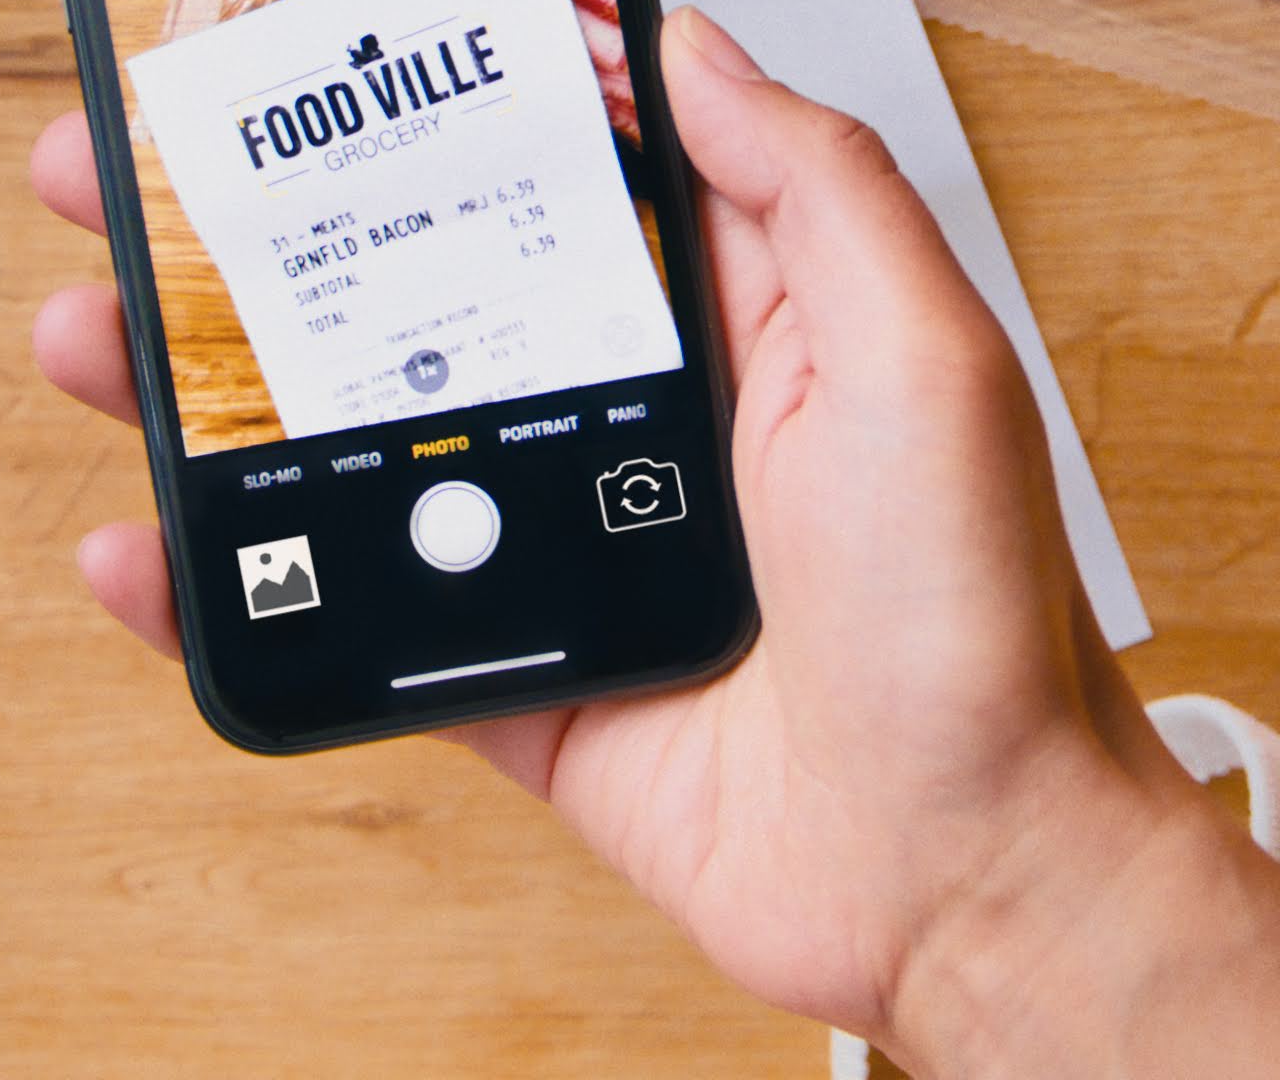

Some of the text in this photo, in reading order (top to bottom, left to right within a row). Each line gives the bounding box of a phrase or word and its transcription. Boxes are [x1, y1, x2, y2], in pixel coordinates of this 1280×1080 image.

[236, 24, 505, 171] FOOD VILLE
[323, 112, 444, 173] GROCERY
[282, 236, 359, 279] GRNFLD
[371, 209, 434, 249] BACON
[496, 178, 537, 206] 6.39
[295, 204, 546, 308] SUBTOTAL 6.39
[311, 211, 357, 240] MEATS
[306, 233, 557, 337] TOTAL 6.39
[242, 402, 648, 491] SLO-MO VIDEO PHOTO PORTRAIT PANO
